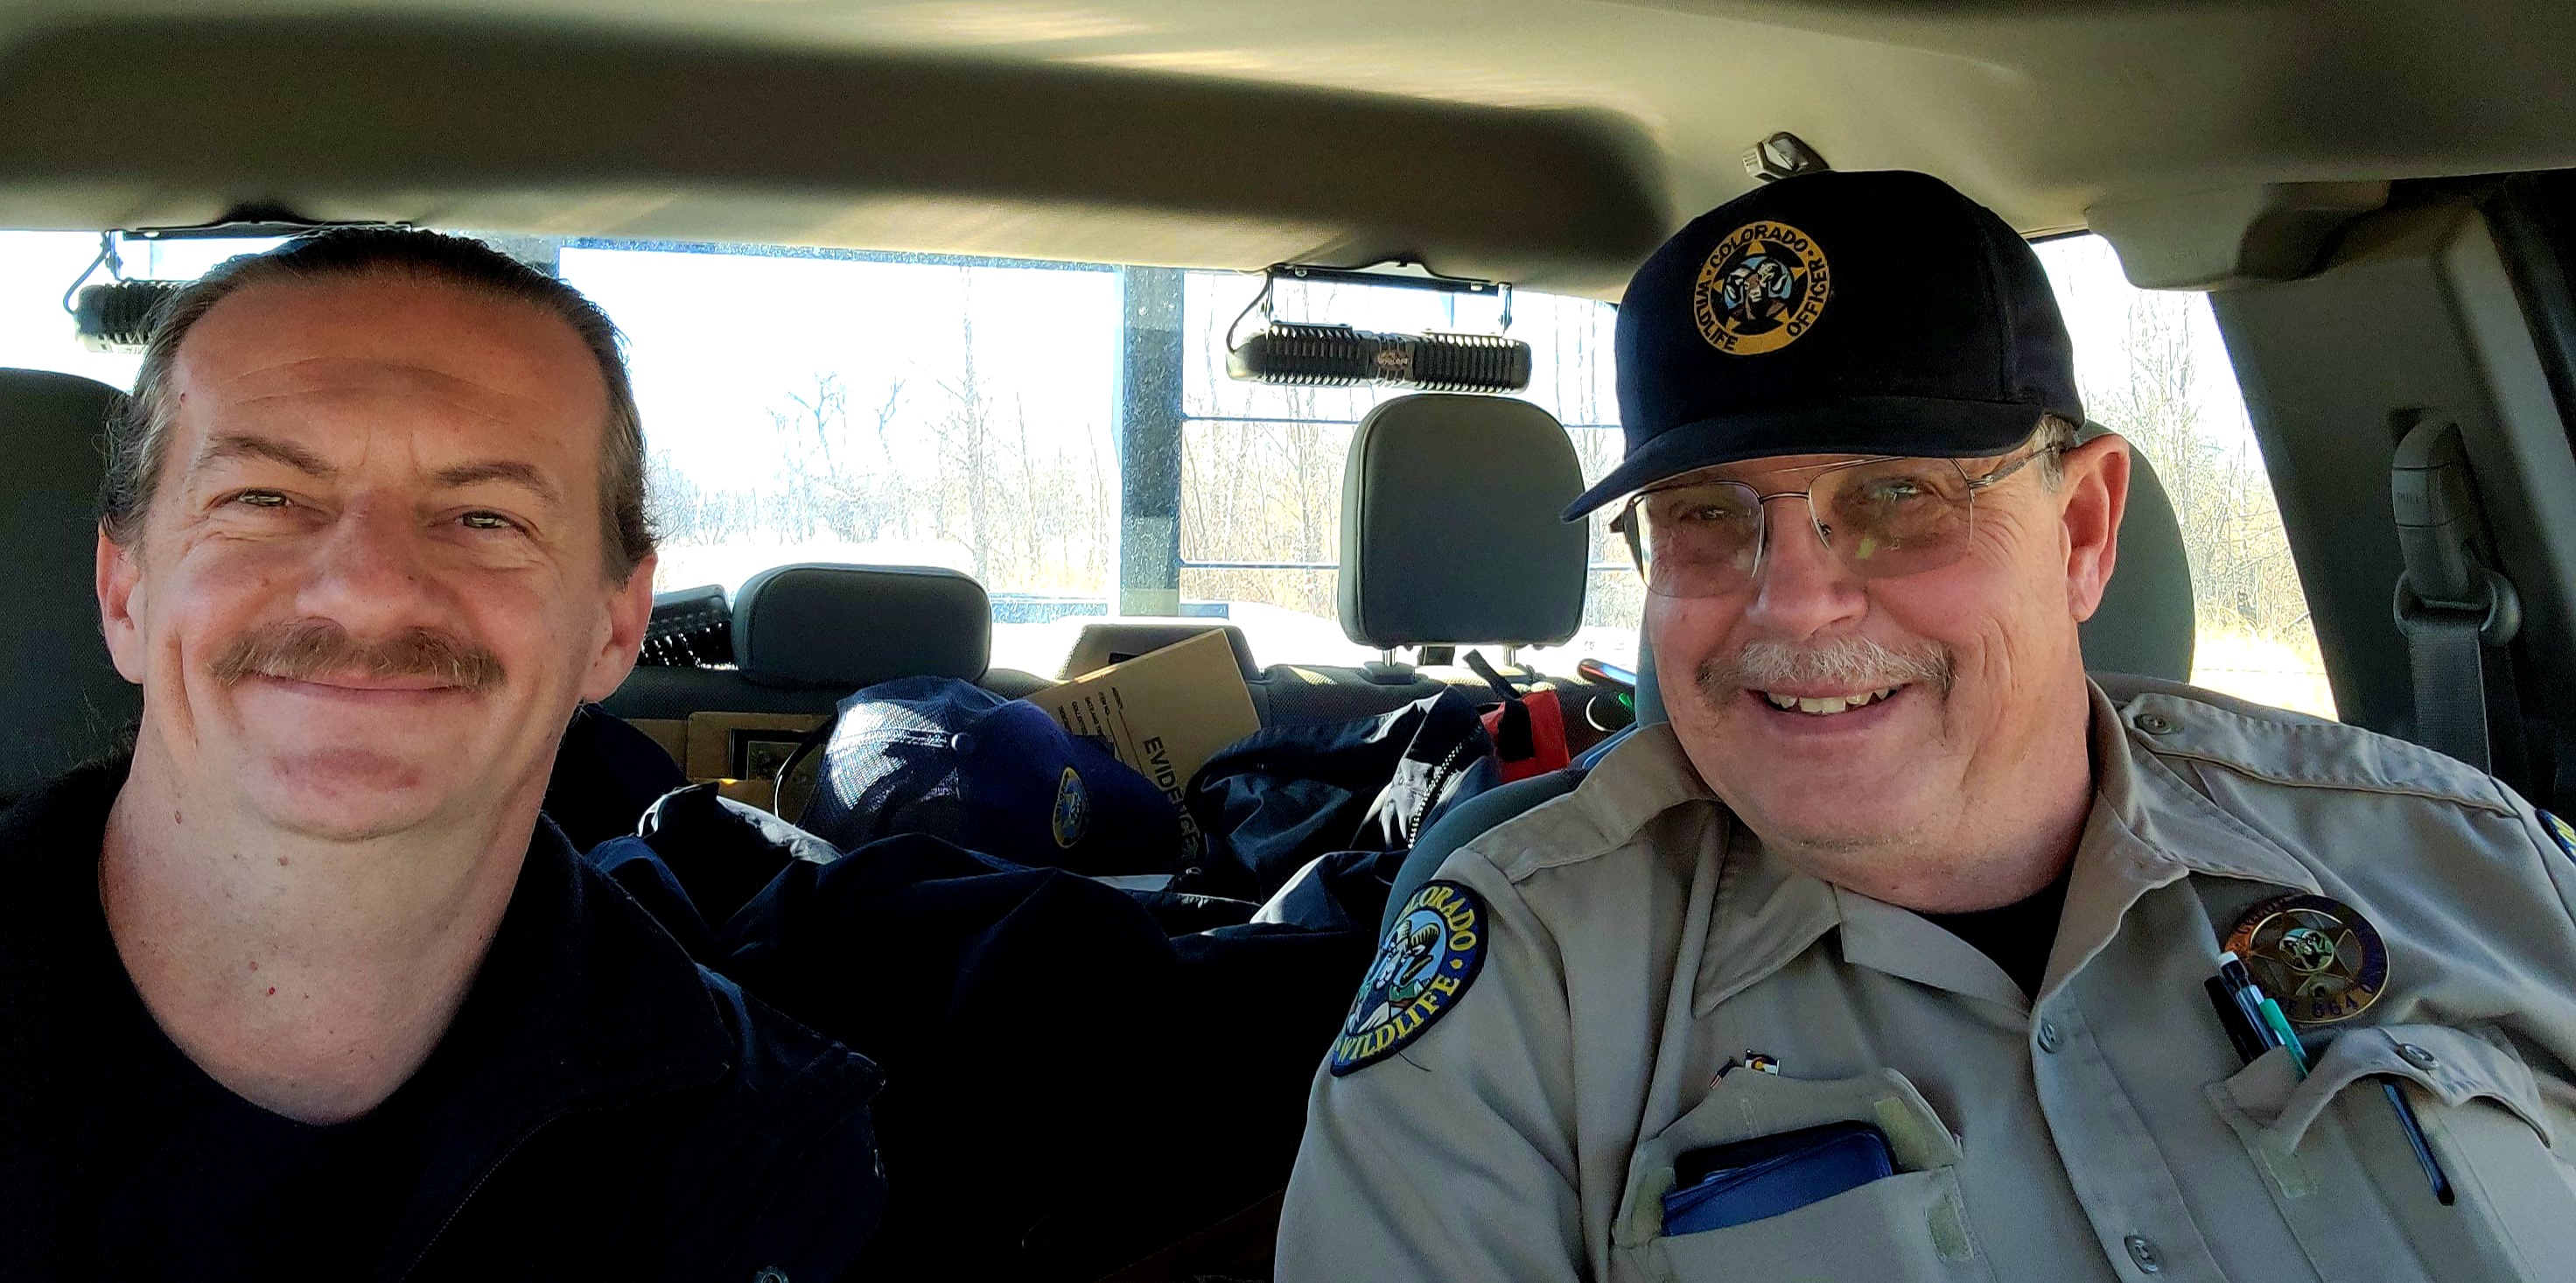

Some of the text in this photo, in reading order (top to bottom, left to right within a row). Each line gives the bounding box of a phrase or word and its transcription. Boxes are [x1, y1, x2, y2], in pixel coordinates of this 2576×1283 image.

[1710, 224, 1809, 268] COLORADO
[1696, 278, 1739, 351] WILDLIFE
[1787, 257, 1827, 337] OFFICER
[1142, 736, 1199, 855] EVIDECE
[1335, 973, 1460, 1063] WILDLIFE
